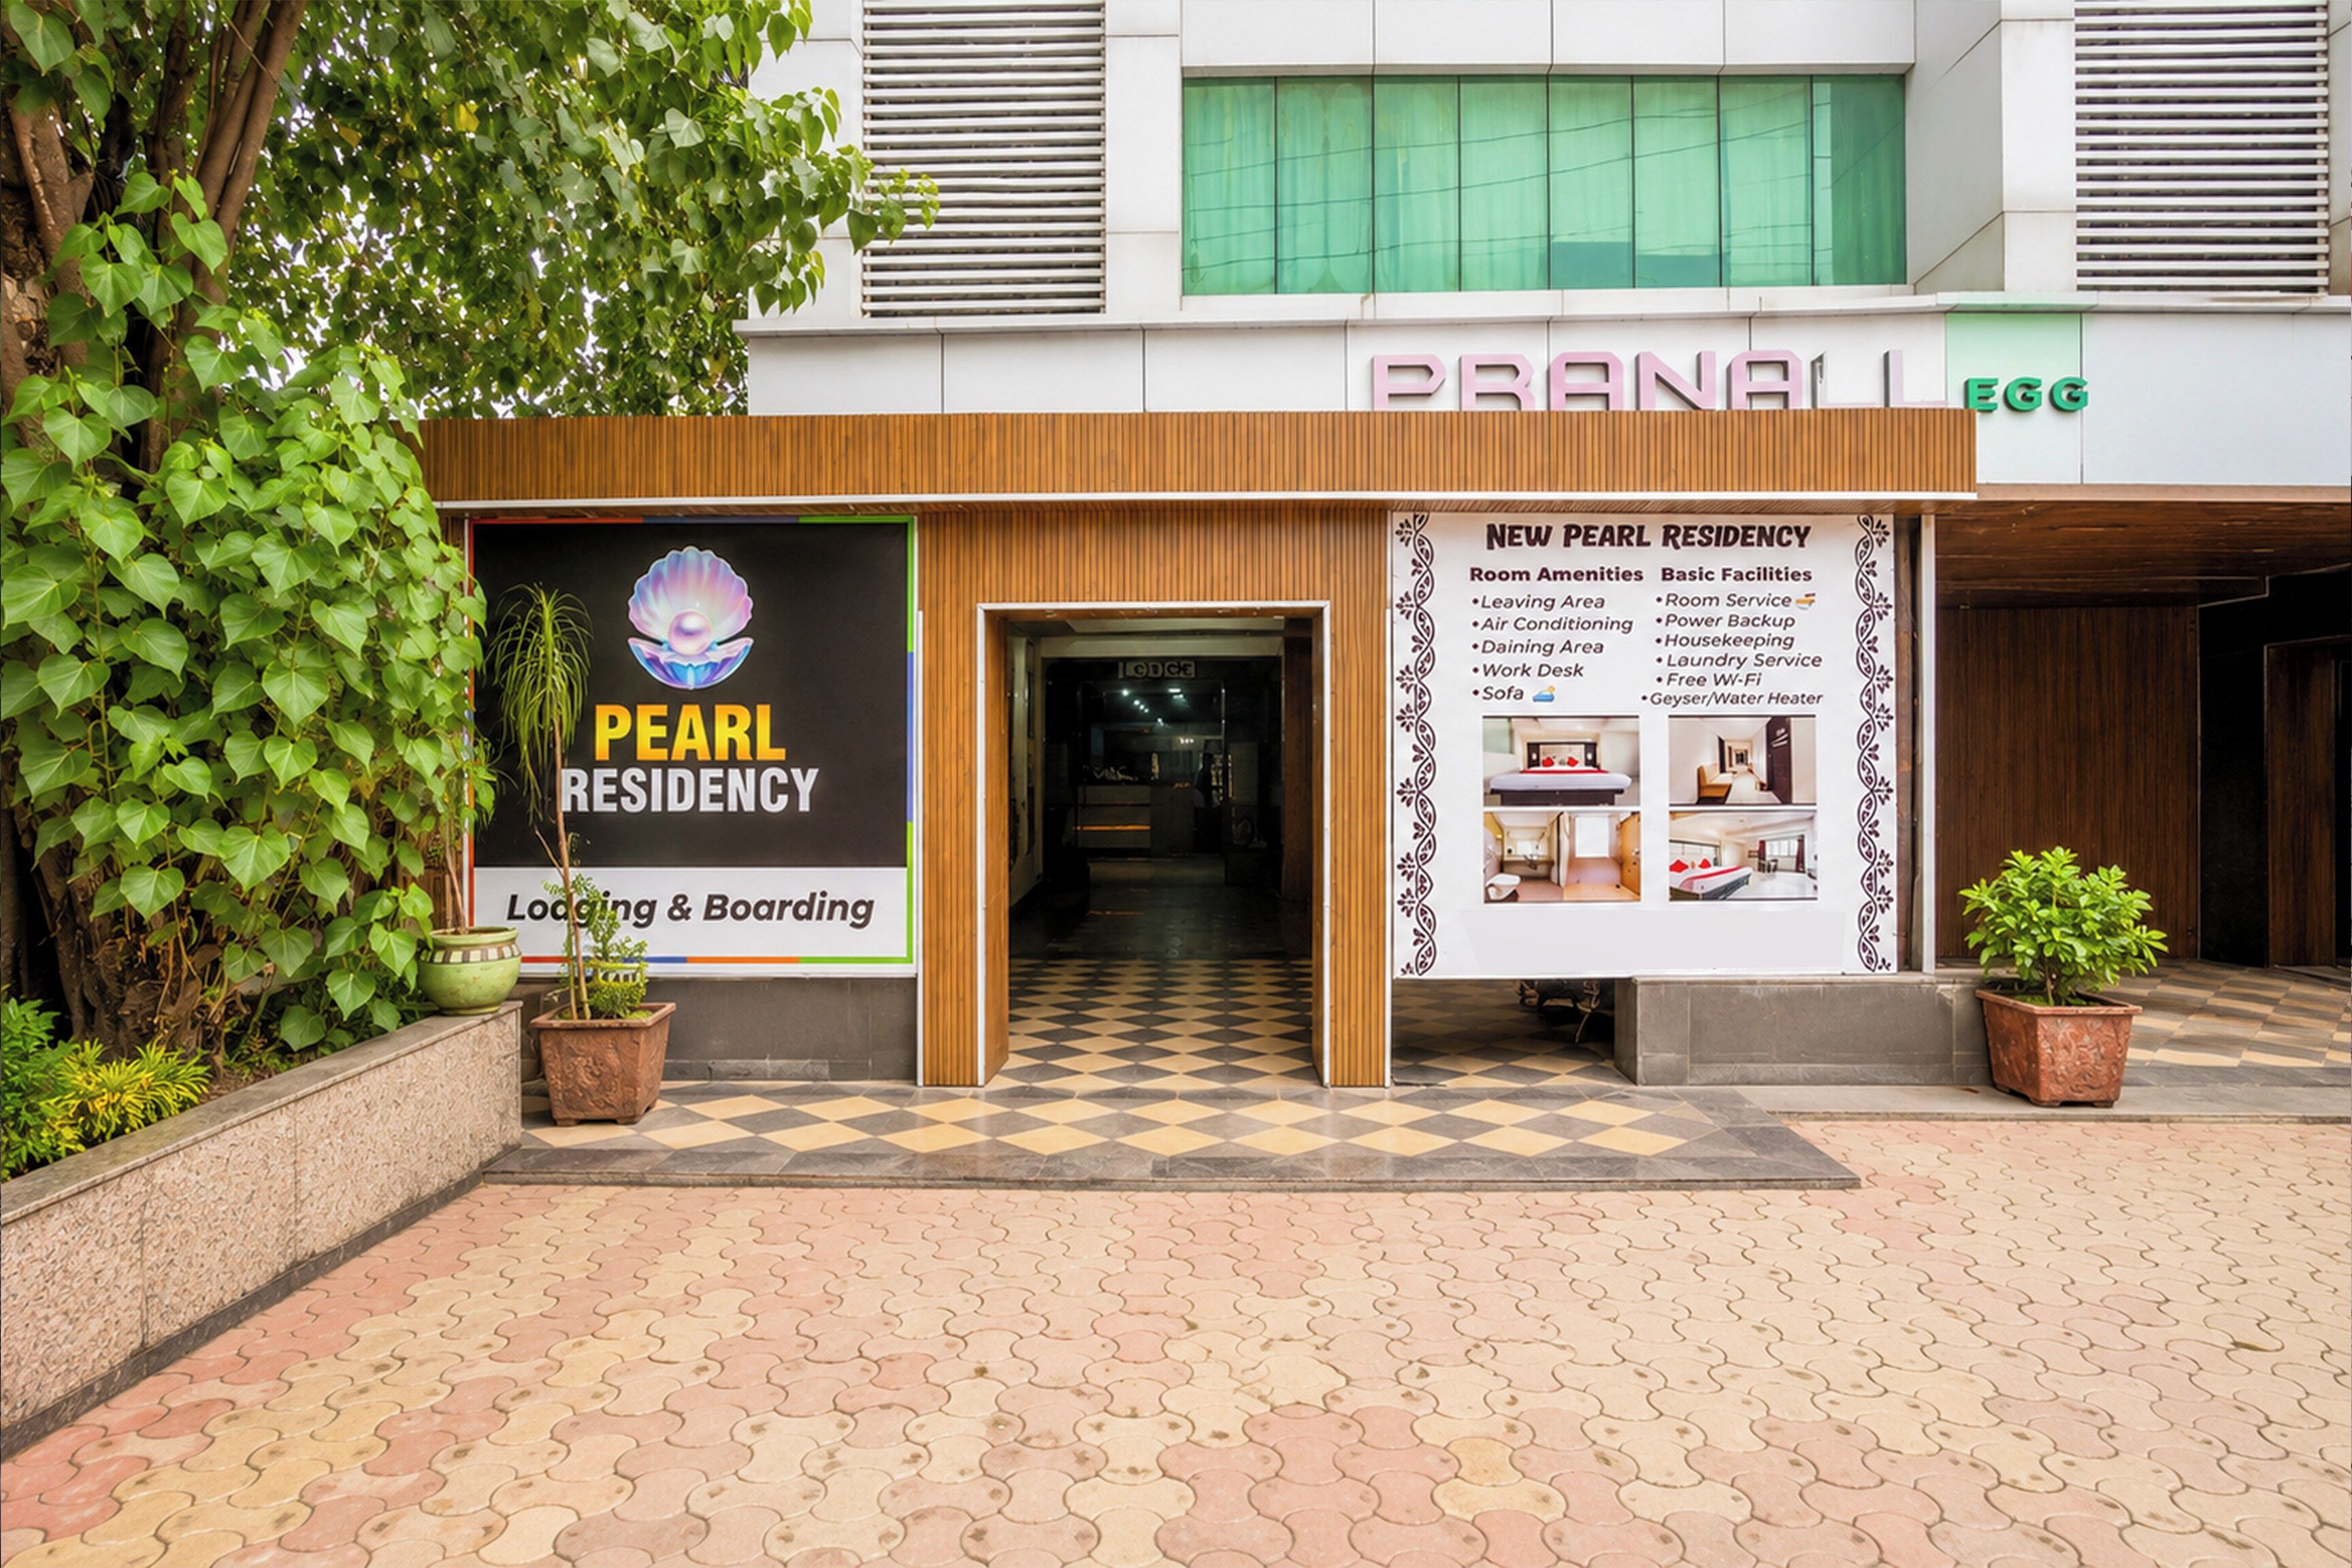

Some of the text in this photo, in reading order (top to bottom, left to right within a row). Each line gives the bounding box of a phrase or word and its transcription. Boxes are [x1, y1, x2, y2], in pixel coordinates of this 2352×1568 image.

[1964, 376, 2089, 412] EGG
[1486, 523, 1812, 550] NEW PEARL RESIDENCY
[1470, 566, 1644, 582] Room Amenities
[1661, 566, 1812, 582] Basic Facilities
[1481, 594, 1605, 612] Leaving Area
[1665, 592, 1792, 607] Room Service
[1481, 617, 1633, 634] Air Conditioning
[1665, 614, 1795, 630] Power Backup
[1482, 639, 1604, 657] Daining Area
[1665, 633, 1795, 650] Housekeeping
[1667, 653, 1823, 670] Laundry Service
[1482, 664, 1584, 677] Work Desk
[1667, 673, 1707, 686] Free
[1482, 686, 1524, 700] Sofa
[1650, 691, 1823, 708] Geyser/Water Heater
[595, 704, 786, 761] PEARL
[560, 768, 819, 813] RESIDENCY
[667, 894, 692, 921] &
[703, 892, 874, 929] Boarding
